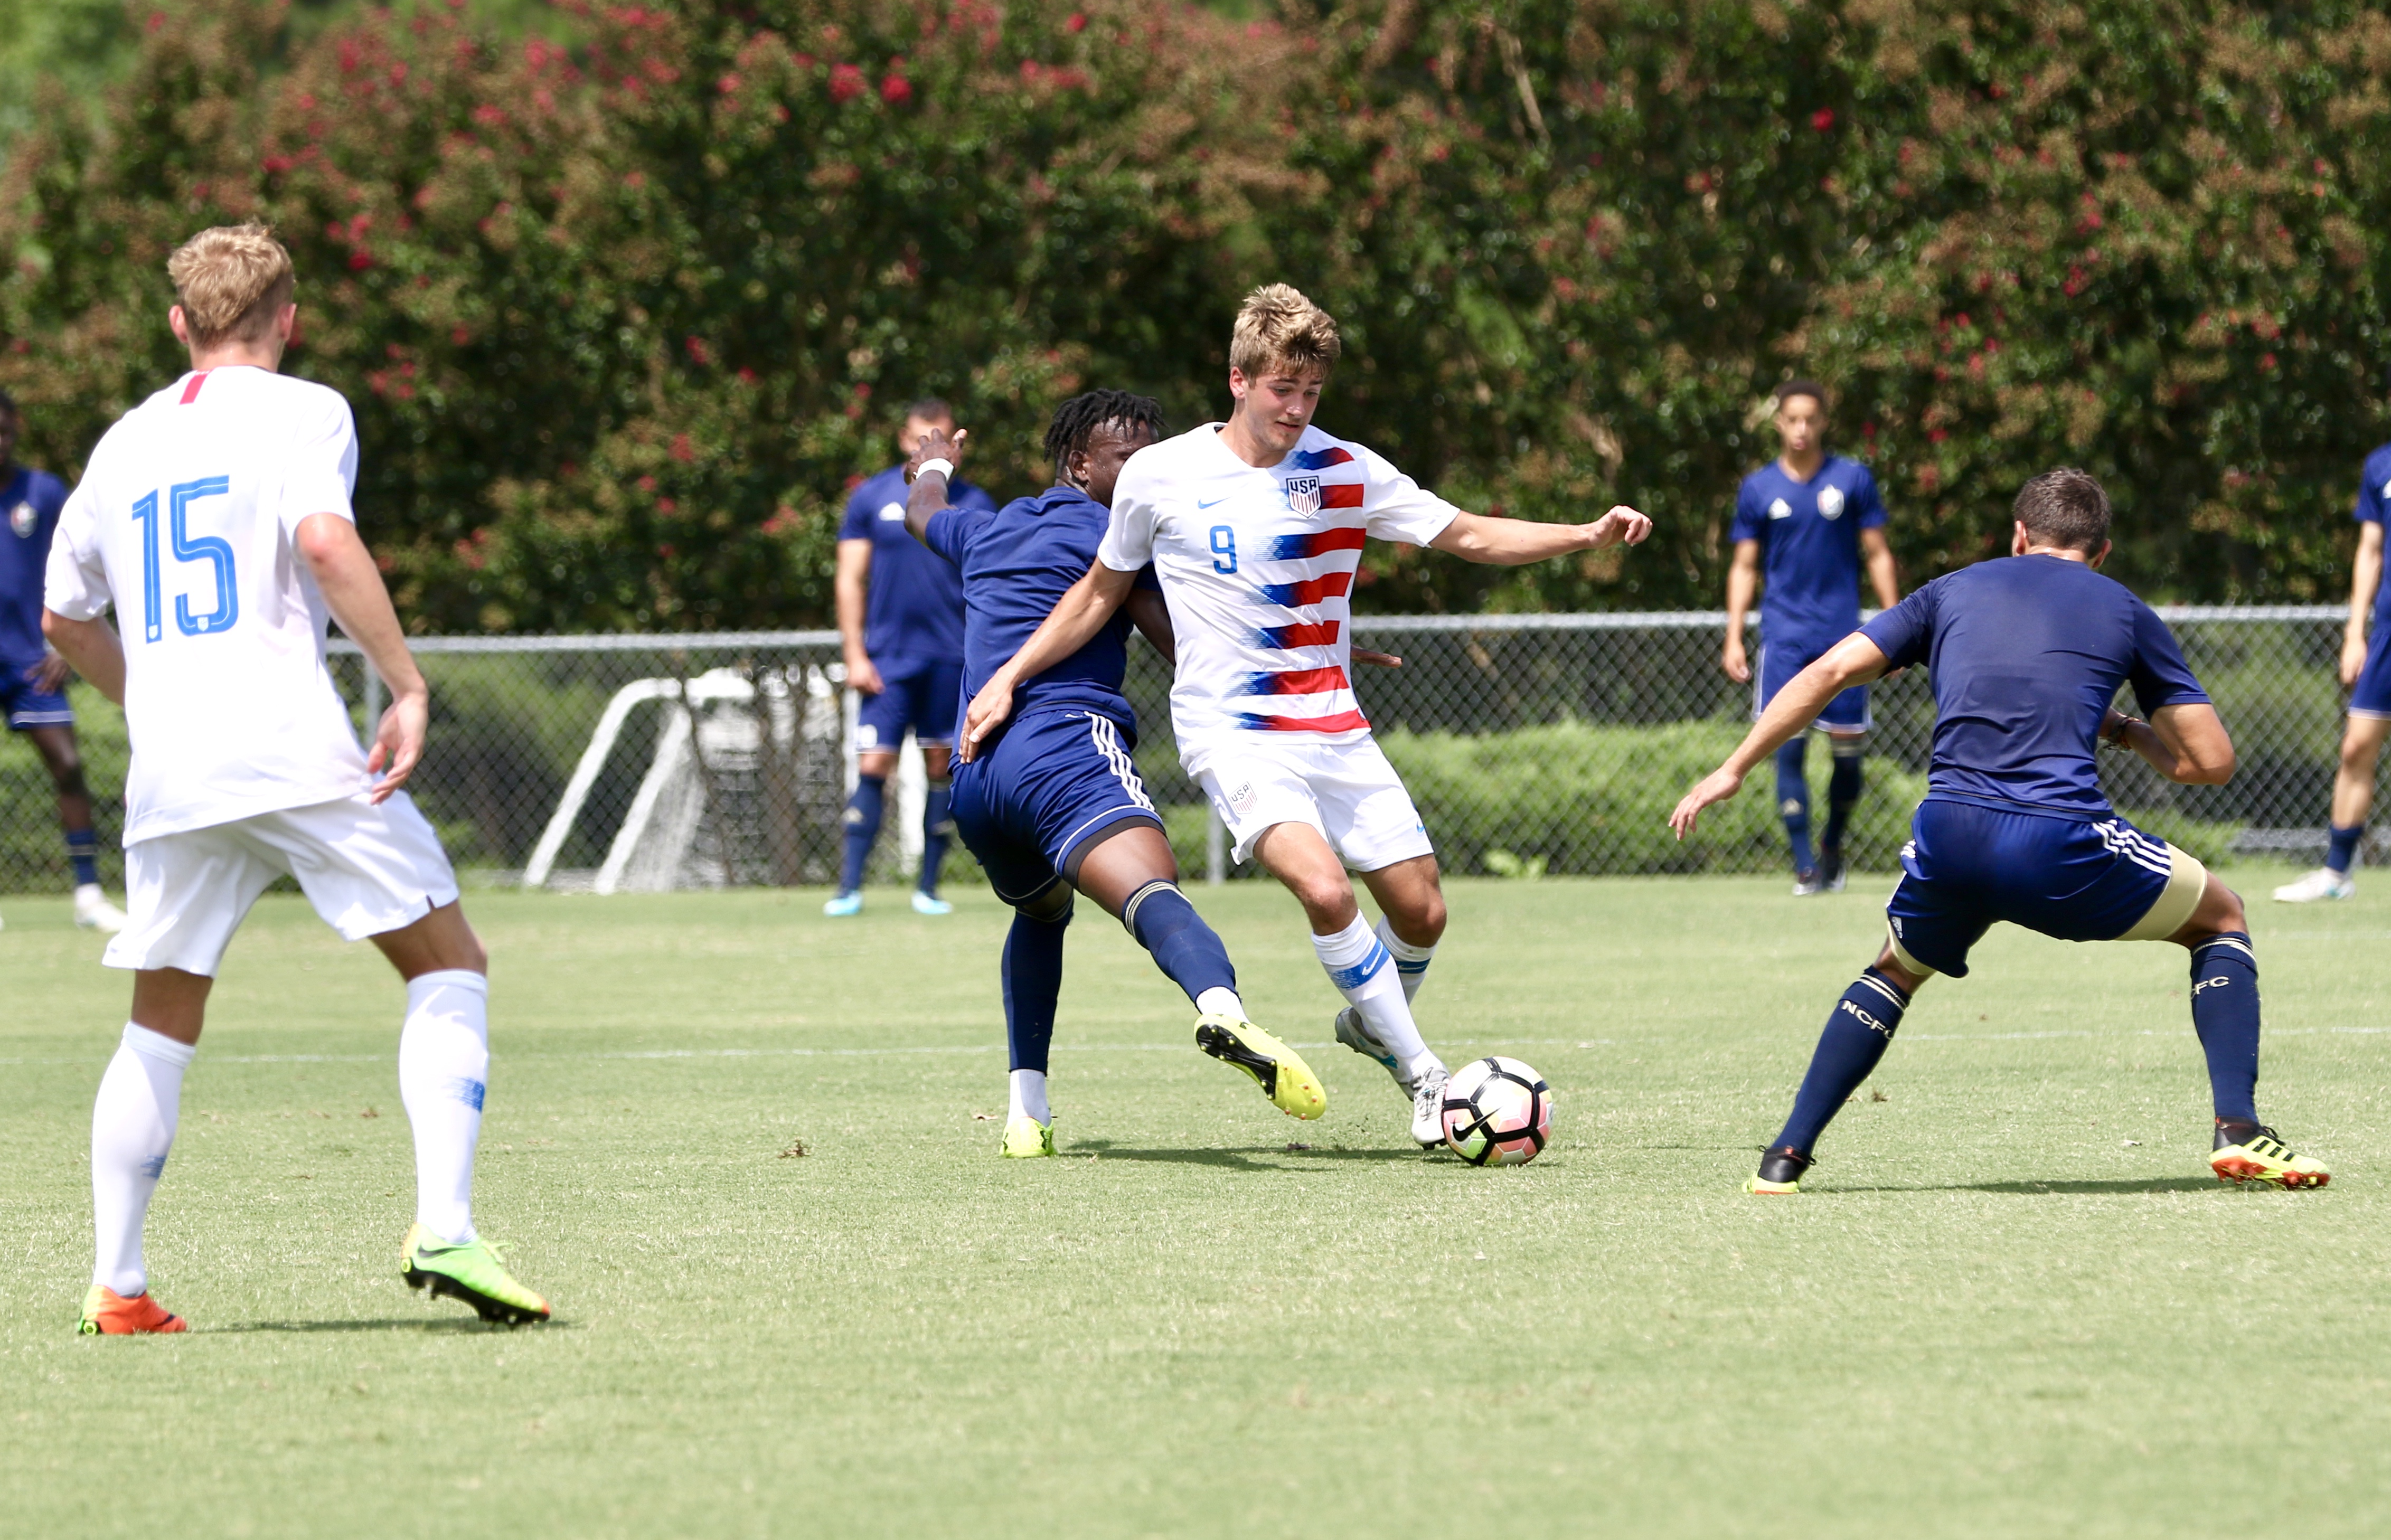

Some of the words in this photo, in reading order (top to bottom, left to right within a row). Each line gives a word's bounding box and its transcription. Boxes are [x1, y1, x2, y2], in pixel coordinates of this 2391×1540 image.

[1290, 479, 1316, 494] USA
[132, 475, 238, 644] 15
[1209, 525, 1238, 575] 9
[1231, 784, 1249, 802] USA
